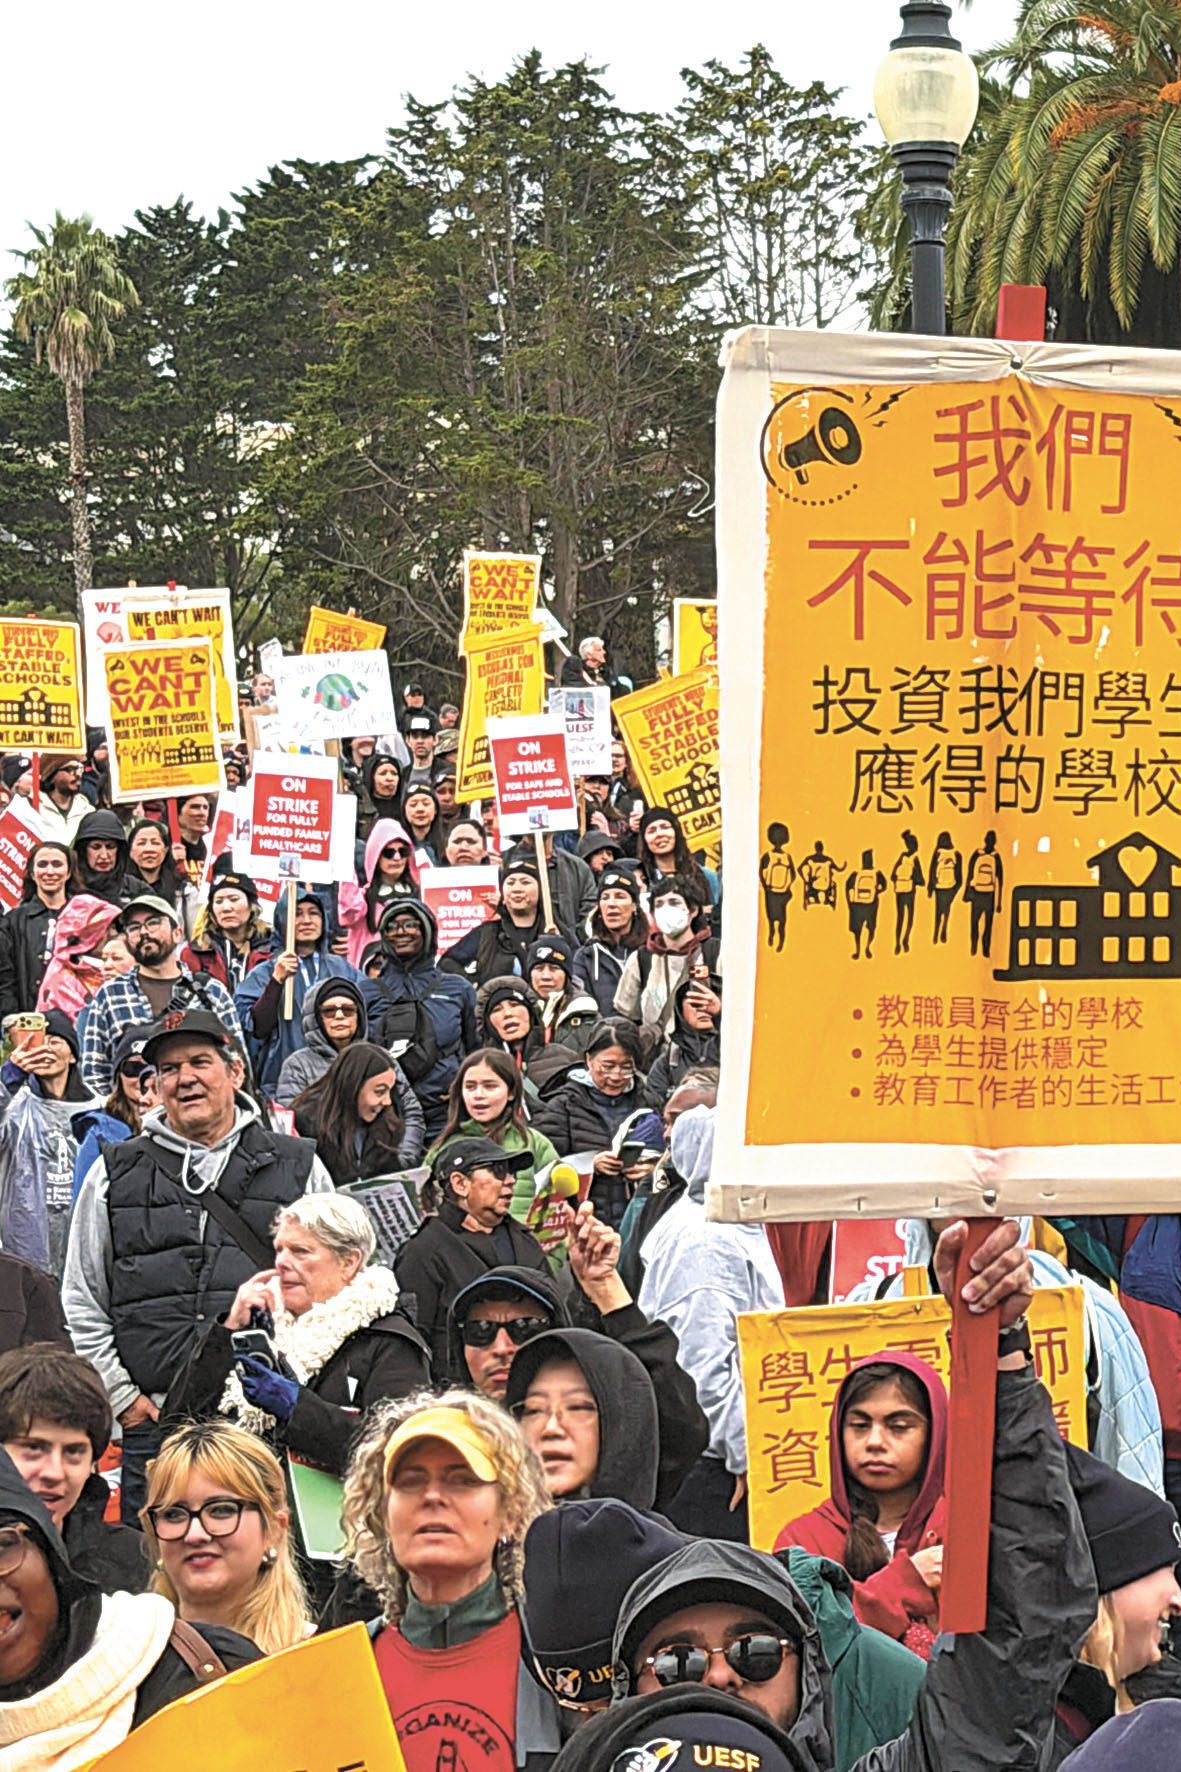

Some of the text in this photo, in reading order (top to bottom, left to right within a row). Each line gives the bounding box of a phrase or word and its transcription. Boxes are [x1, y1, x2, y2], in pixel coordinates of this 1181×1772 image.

[933, 395, 1132, 515] 我們
[483, 564, 519, 577] WE
[471, 588, 527, 601] WAIT
[95, 602, 121, 614] WE
[133, 612, 151, 627] WE
[193, 606, 221, 622] WAIT
[0, 648, 71, 664] TAFFED,
[129, 656, 184, 676] WE
[112, 690, 201, 713] WAIT
[649, 699, 706, 732] FULLY
[518, 741, 541, 755] ON
[650, 723, 719, 762] STABLE
[508, 758, 556, 775] STRIKE
[650, 739, 719, 776] SCHOO
[281, 777, 308, 795] ON
[268, 797, 319, 814] STRIKE
[266, 812, 318, 827] FOR FULLY
[16, 831, 36, 852] ON
[253, 825, 329, 841] FUNDED FAMILY
[259, 838, 322, 854] HEALTHCARE
[448, 887, 473, 902] ON
[437, 904, 486, 920] STRIKE
[876, 994, 1144, 1033] 教職員齊全的學校
[875, 1033, 1109, 1071] 為學生提供穩定
[401, 1712, 500, 1756] GANIZE
[694, 1745, 760, 1772] UESF
